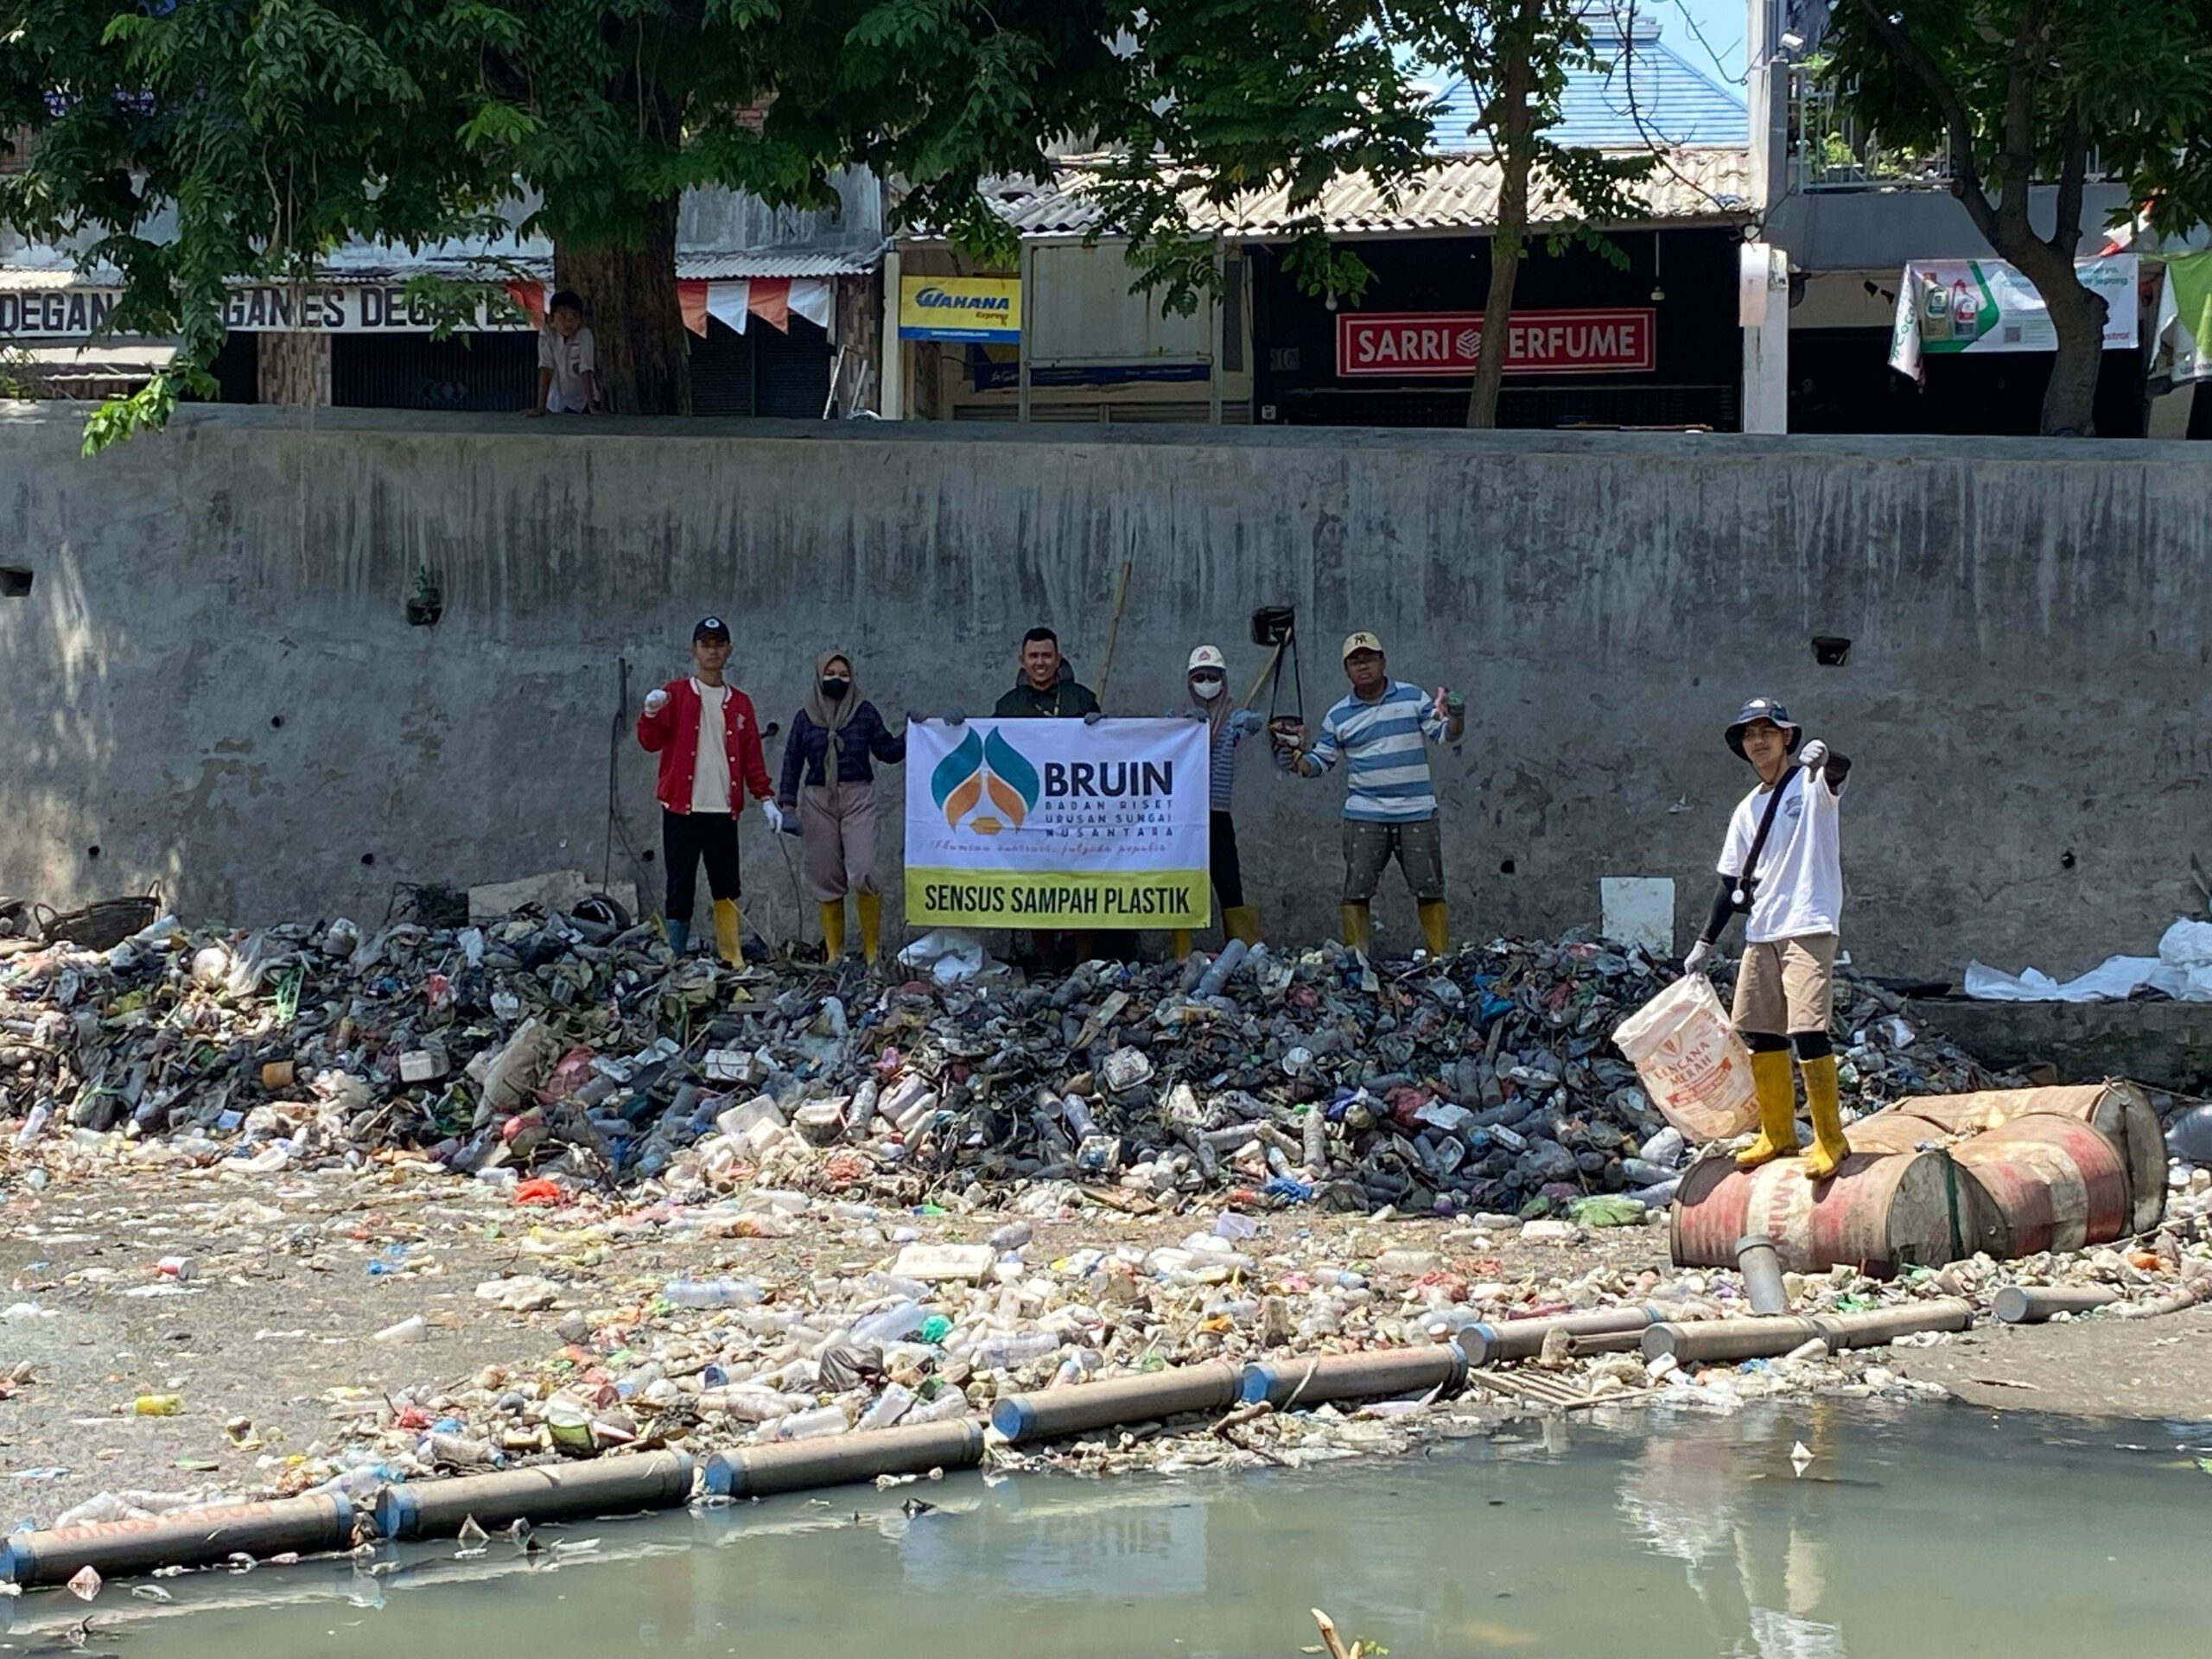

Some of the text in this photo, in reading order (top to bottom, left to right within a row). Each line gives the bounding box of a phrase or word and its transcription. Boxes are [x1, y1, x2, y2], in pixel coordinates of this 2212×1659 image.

[915, 287, 1009, 309] WAHANA
[1358, 325, 1636, 362] SARRI ERFUME
[1045, 760, 1173, 797] BRUIN
[1045, 799, 1173, 810] BADAN RISET
[1046, 813, 1172, 823] URUSAN SUNGAI
[1046, 827, 1173, 837] NUSANTARA
[925, 884, 1191, 914] SENSUS SAMPAH PLASTIK
[1655, 1041, 1710, 1080] LENCANA
